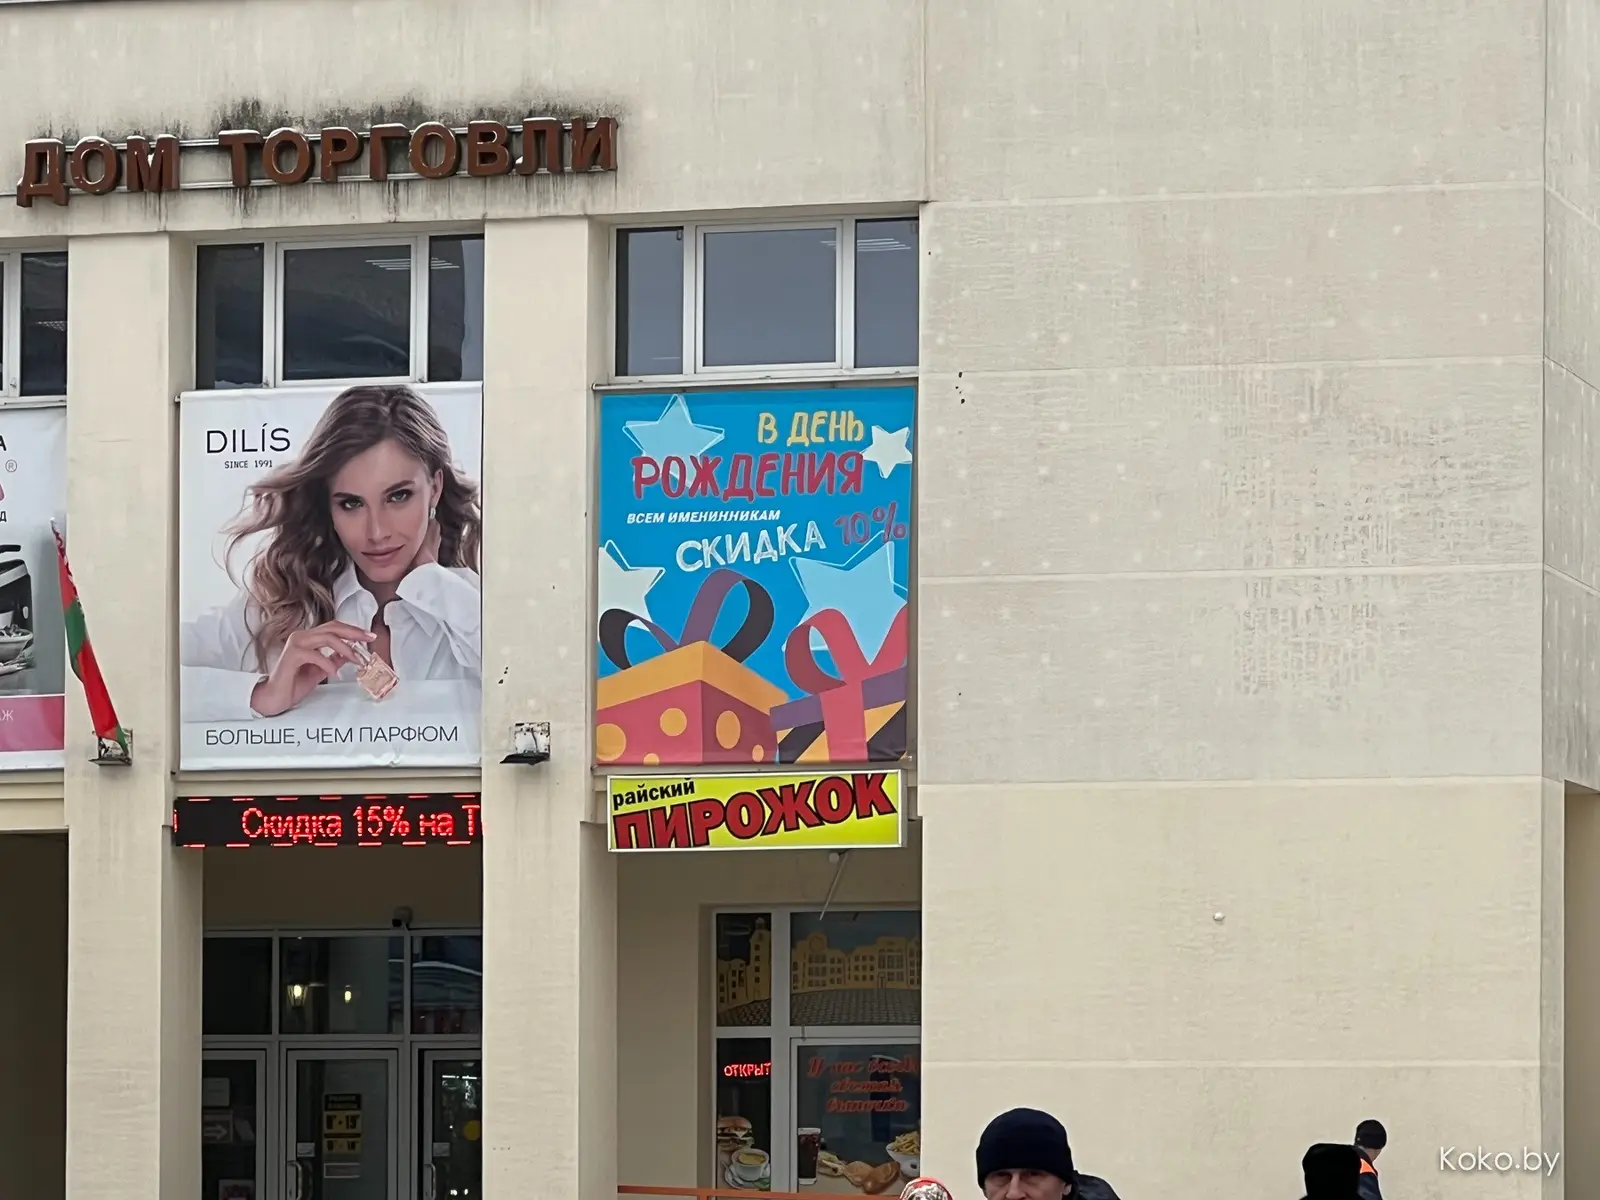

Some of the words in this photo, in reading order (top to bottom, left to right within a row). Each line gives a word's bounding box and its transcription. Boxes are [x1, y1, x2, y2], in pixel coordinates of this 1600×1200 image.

[17, 134, 180, 208] ДОМ
[218, 116, 617, 188] ТОРГОВЛИ
[757, 412, 778, 444] В
[786, 410, 865, 447] ДЕНЬ
[224, 460, 249, 469] SINCE
[254, 459, 273, 468] 1991
[631, 451, 864, 503] РОЖДЕНИЯ
[626, 513, 664, 524] ВСЕМ
[667, 509, 782, 524] ИМЕНИННИКАМ
[676, 520, 826, 572] СКИДКА
[834, 501, 908, 546] 10%
[205, 728, 301, 746] БОЛЬШЕ,
[306, 727, 353, 743] ЧЕМ
[359, 725, 458, 743] ПАРФЮМ
[612, 778, 695, 810] райский
[613, 773, 897, 849] ПИРОЖОК
[241, 807, 342, 842] Скидка
[352, 805, 410, 837] 15%
[419, 813, 454, 836] на
